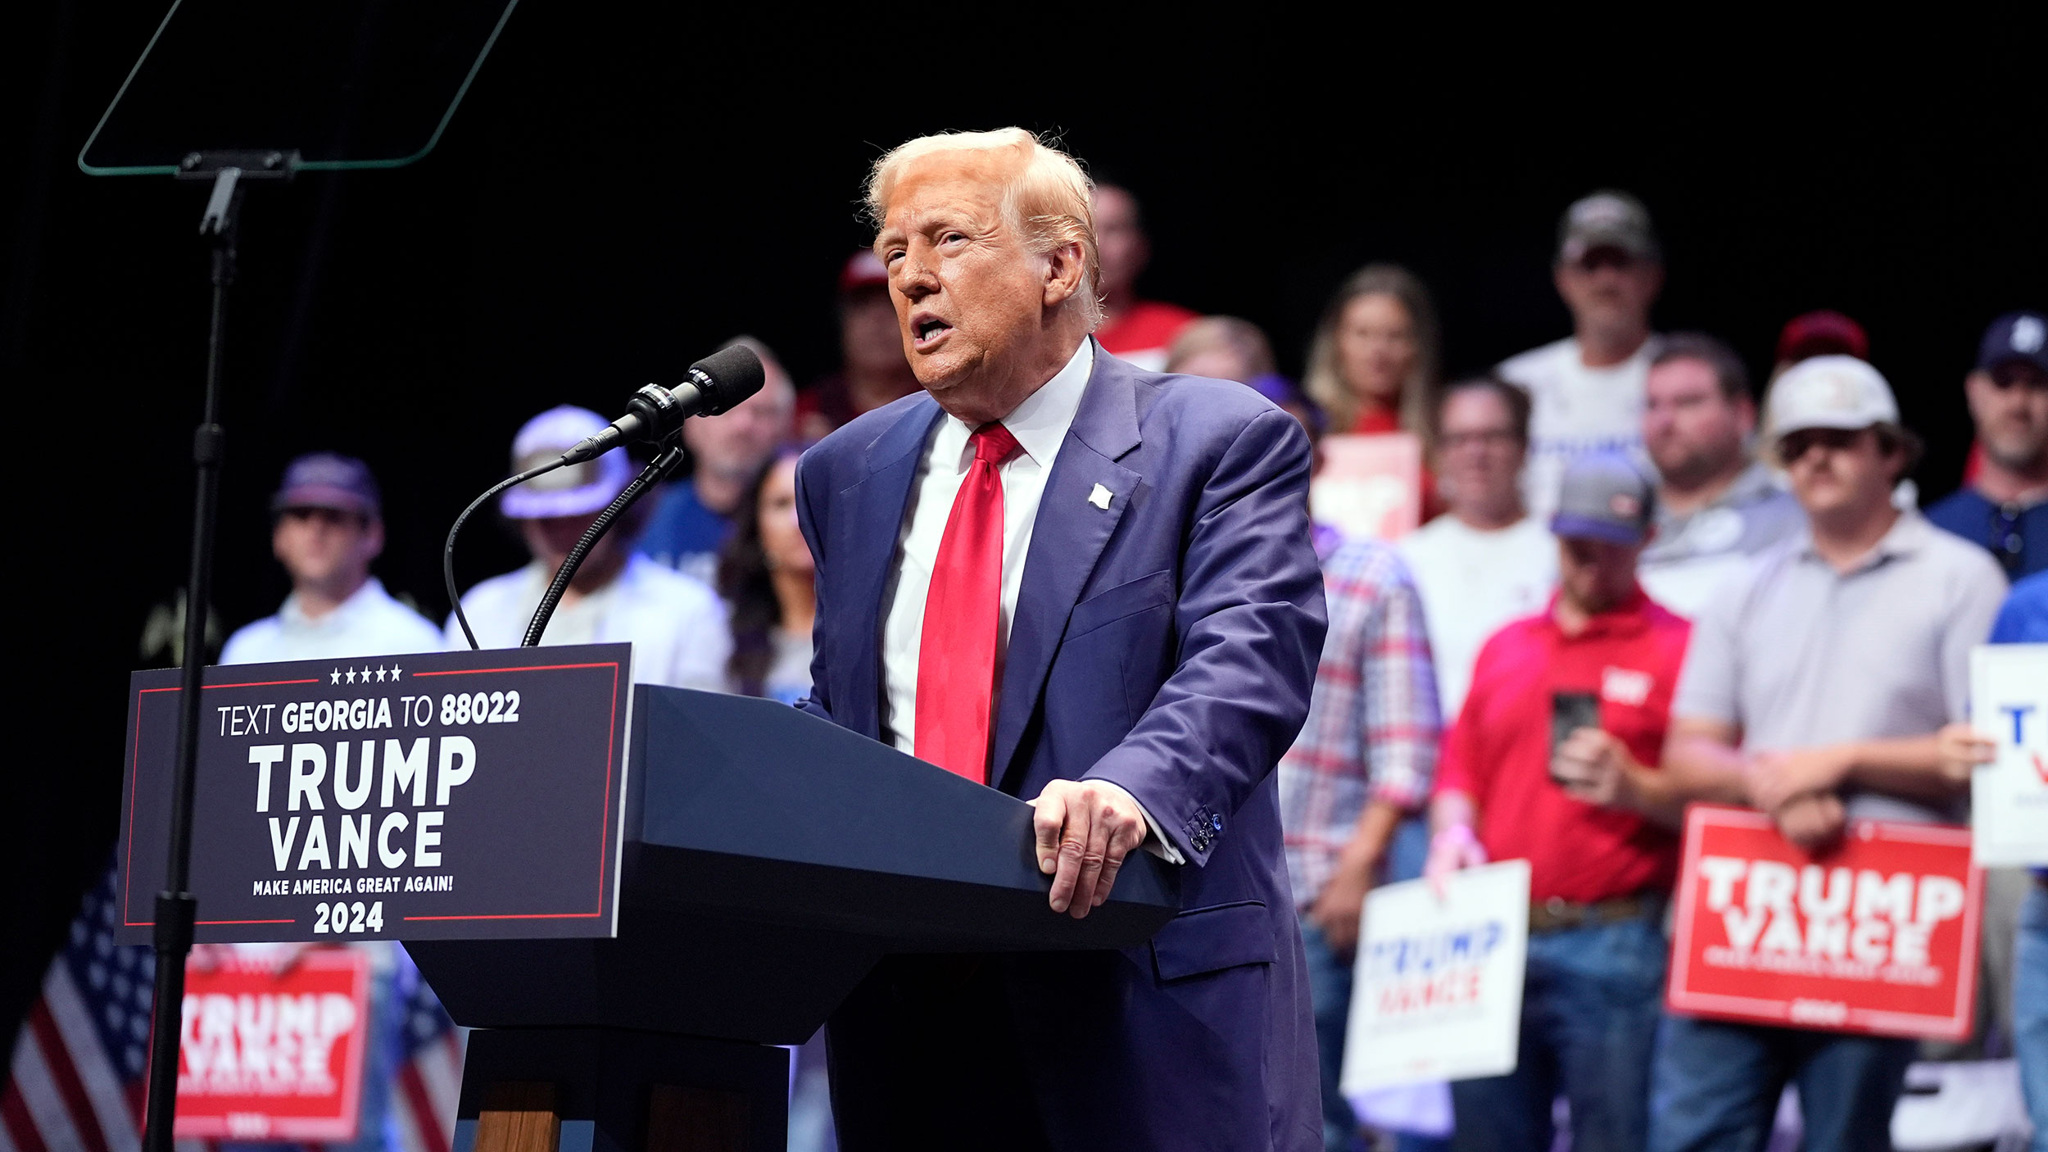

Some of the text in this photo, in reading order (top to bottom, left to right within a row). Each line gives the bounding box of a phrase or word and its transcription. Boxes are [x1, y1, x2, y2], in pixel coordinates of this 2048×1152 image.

[217, 690, 521, 737] TEXT GEORGIA TO 88022
[248, 736, 477, 813] TRUMP
[268, 811, 446, 872] VANCE
[252, 875, 454, 896] MAKE AMERICA GREAT AGAIN!
[1699, 855, 1965, 923] TRUMP
[313, 901, 384, 934] 2024
[1722, 906, 1936, 968] VANCE
